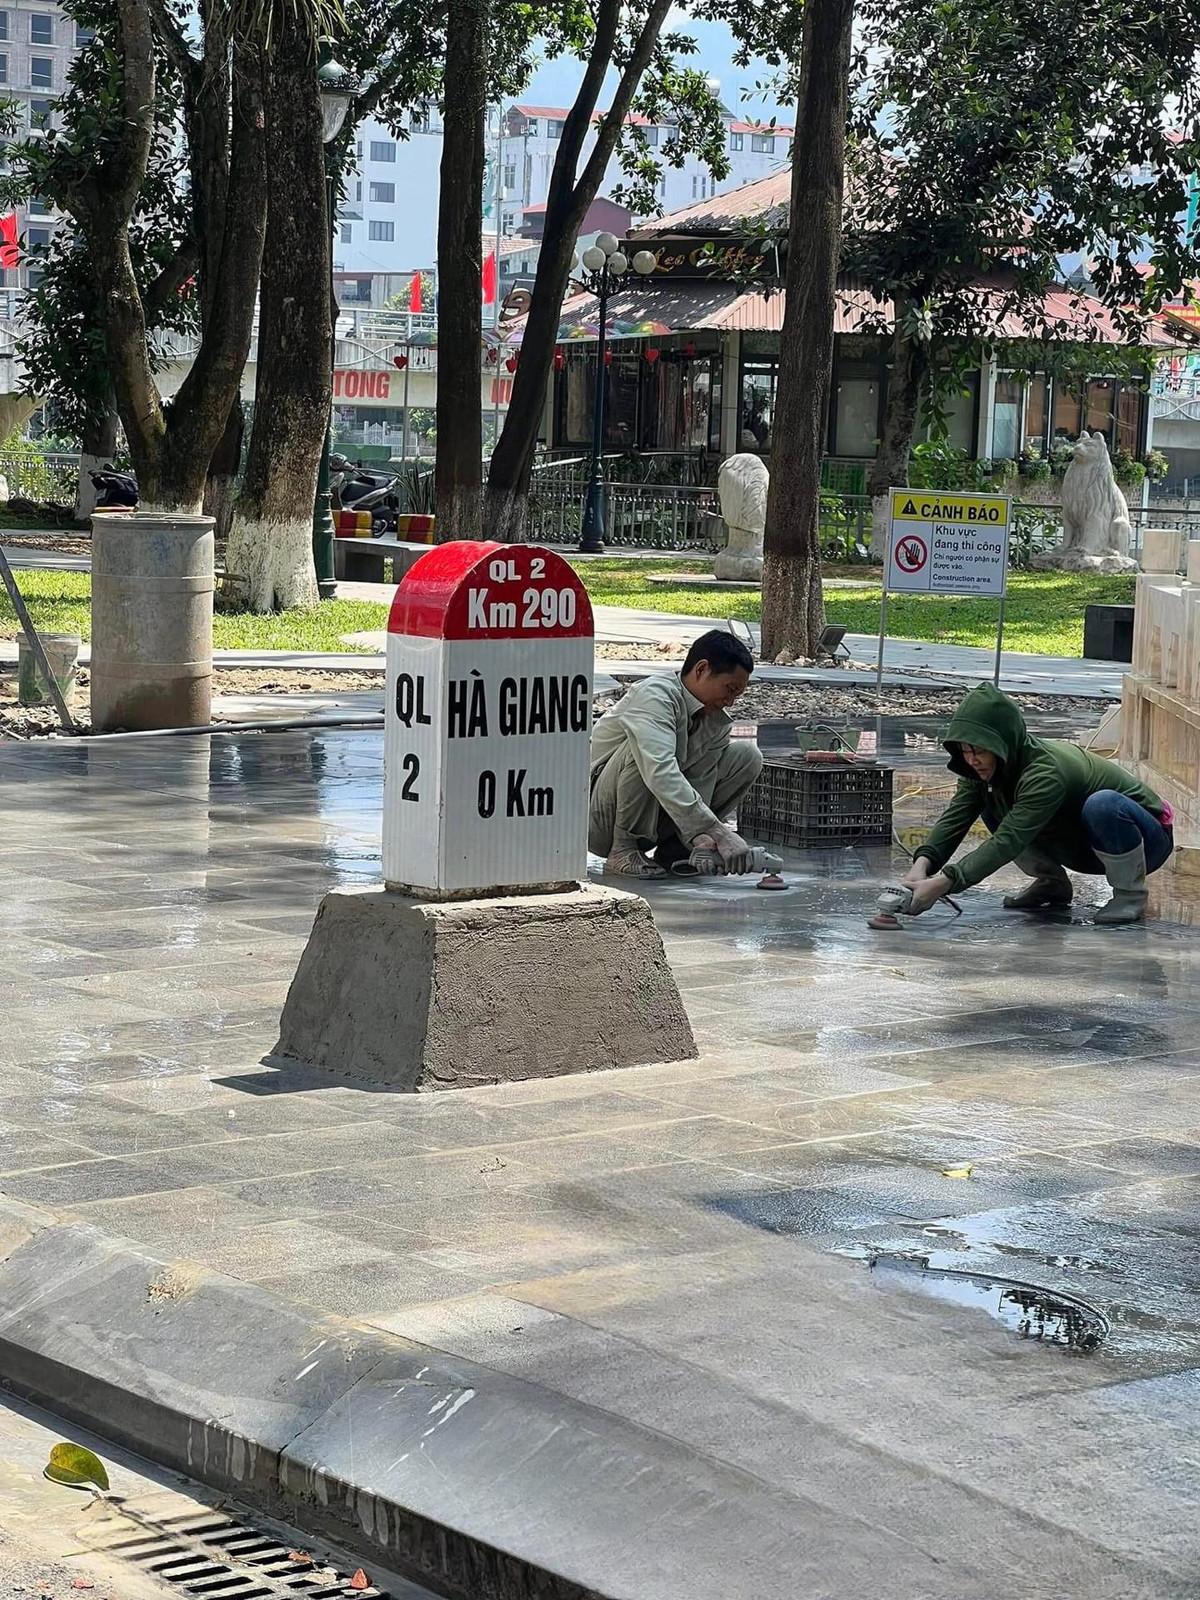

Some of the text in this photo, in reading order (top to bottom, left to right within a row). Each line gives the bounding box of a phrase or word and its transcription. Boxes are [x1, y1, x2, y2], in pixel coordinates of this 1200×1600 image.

[921, 499, 999, 521] CẢNH BÁO
[934, 539, 1001, 554] đang thi công
[935, 525, 977, 539] Khu vực
[489, 558, 546, 583] QL 2
[932, 573, 975, 582] Construction
[468, 587, 576, 629] Km 290
[395, 672, 431, 728] QL
[448, 668, 588, 739] HÀ GIANG
[401, 753, 420, 802] 2
[477, 769, 554, 819] 0 Km
